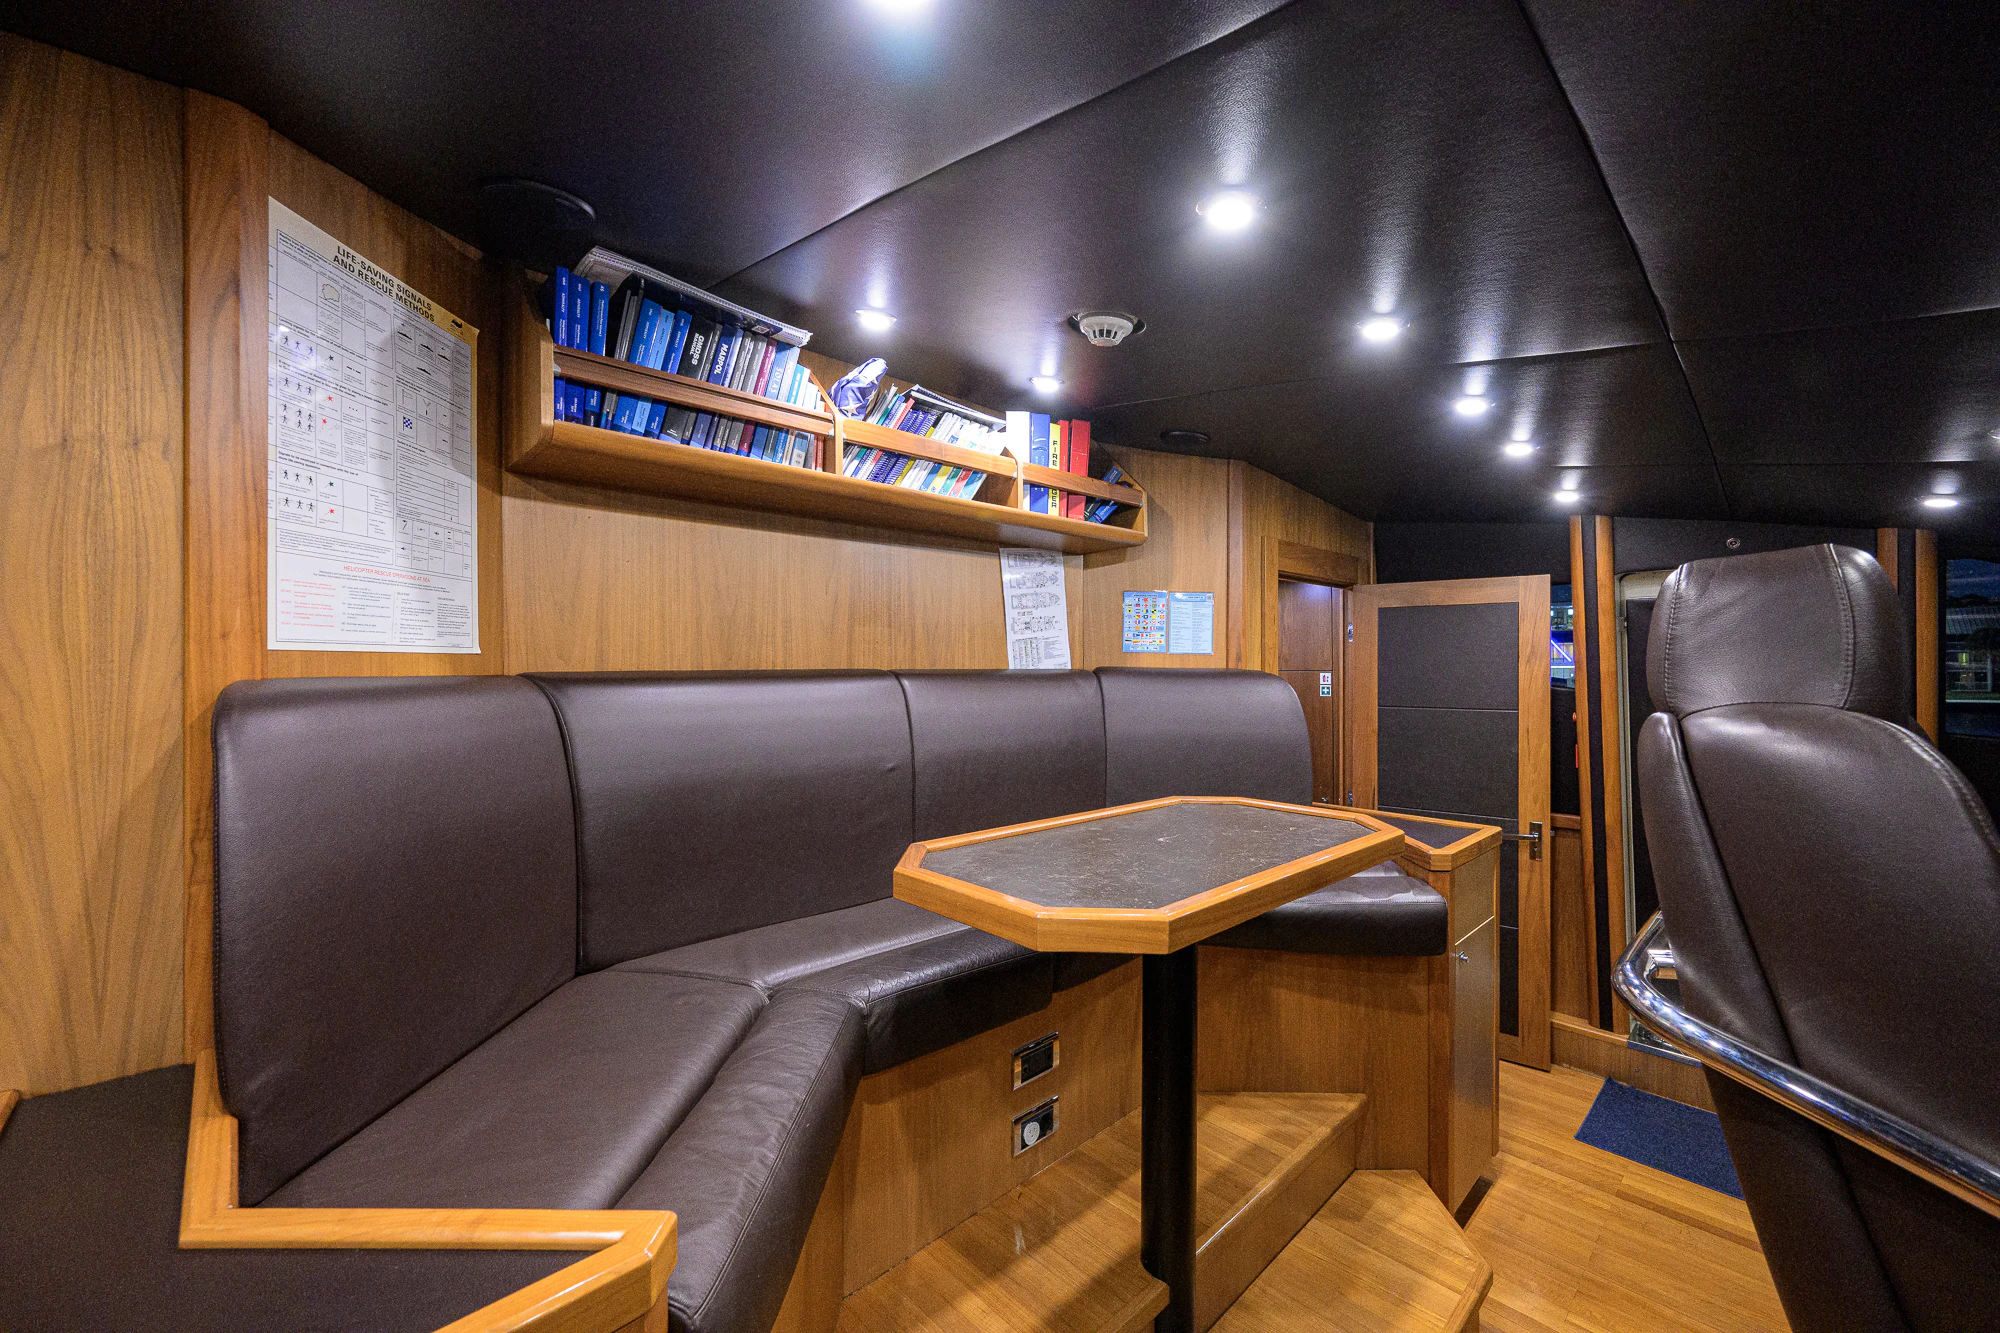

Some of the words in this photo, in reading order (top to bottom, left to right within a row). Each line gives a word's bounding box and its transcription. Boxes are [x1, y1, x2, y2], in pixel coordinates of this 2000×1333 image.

[333, 255, 355, 273] AND
[358, 269, 393, 298] RESCUE
[395, 292, 435, 322] METHODS
[337, 245, 395, 288] LIFE-SAVING
[396, 283, 432, 311] SIGNALS
[691, 335, 705, 366] GMDSS
[714, 343, 729, 375] MARPOL
[771, 366, 783, 394] SOLAS
[344, 565, 373, 574] HELICOPTER
[374, 569, 392, 577] RESCUE
